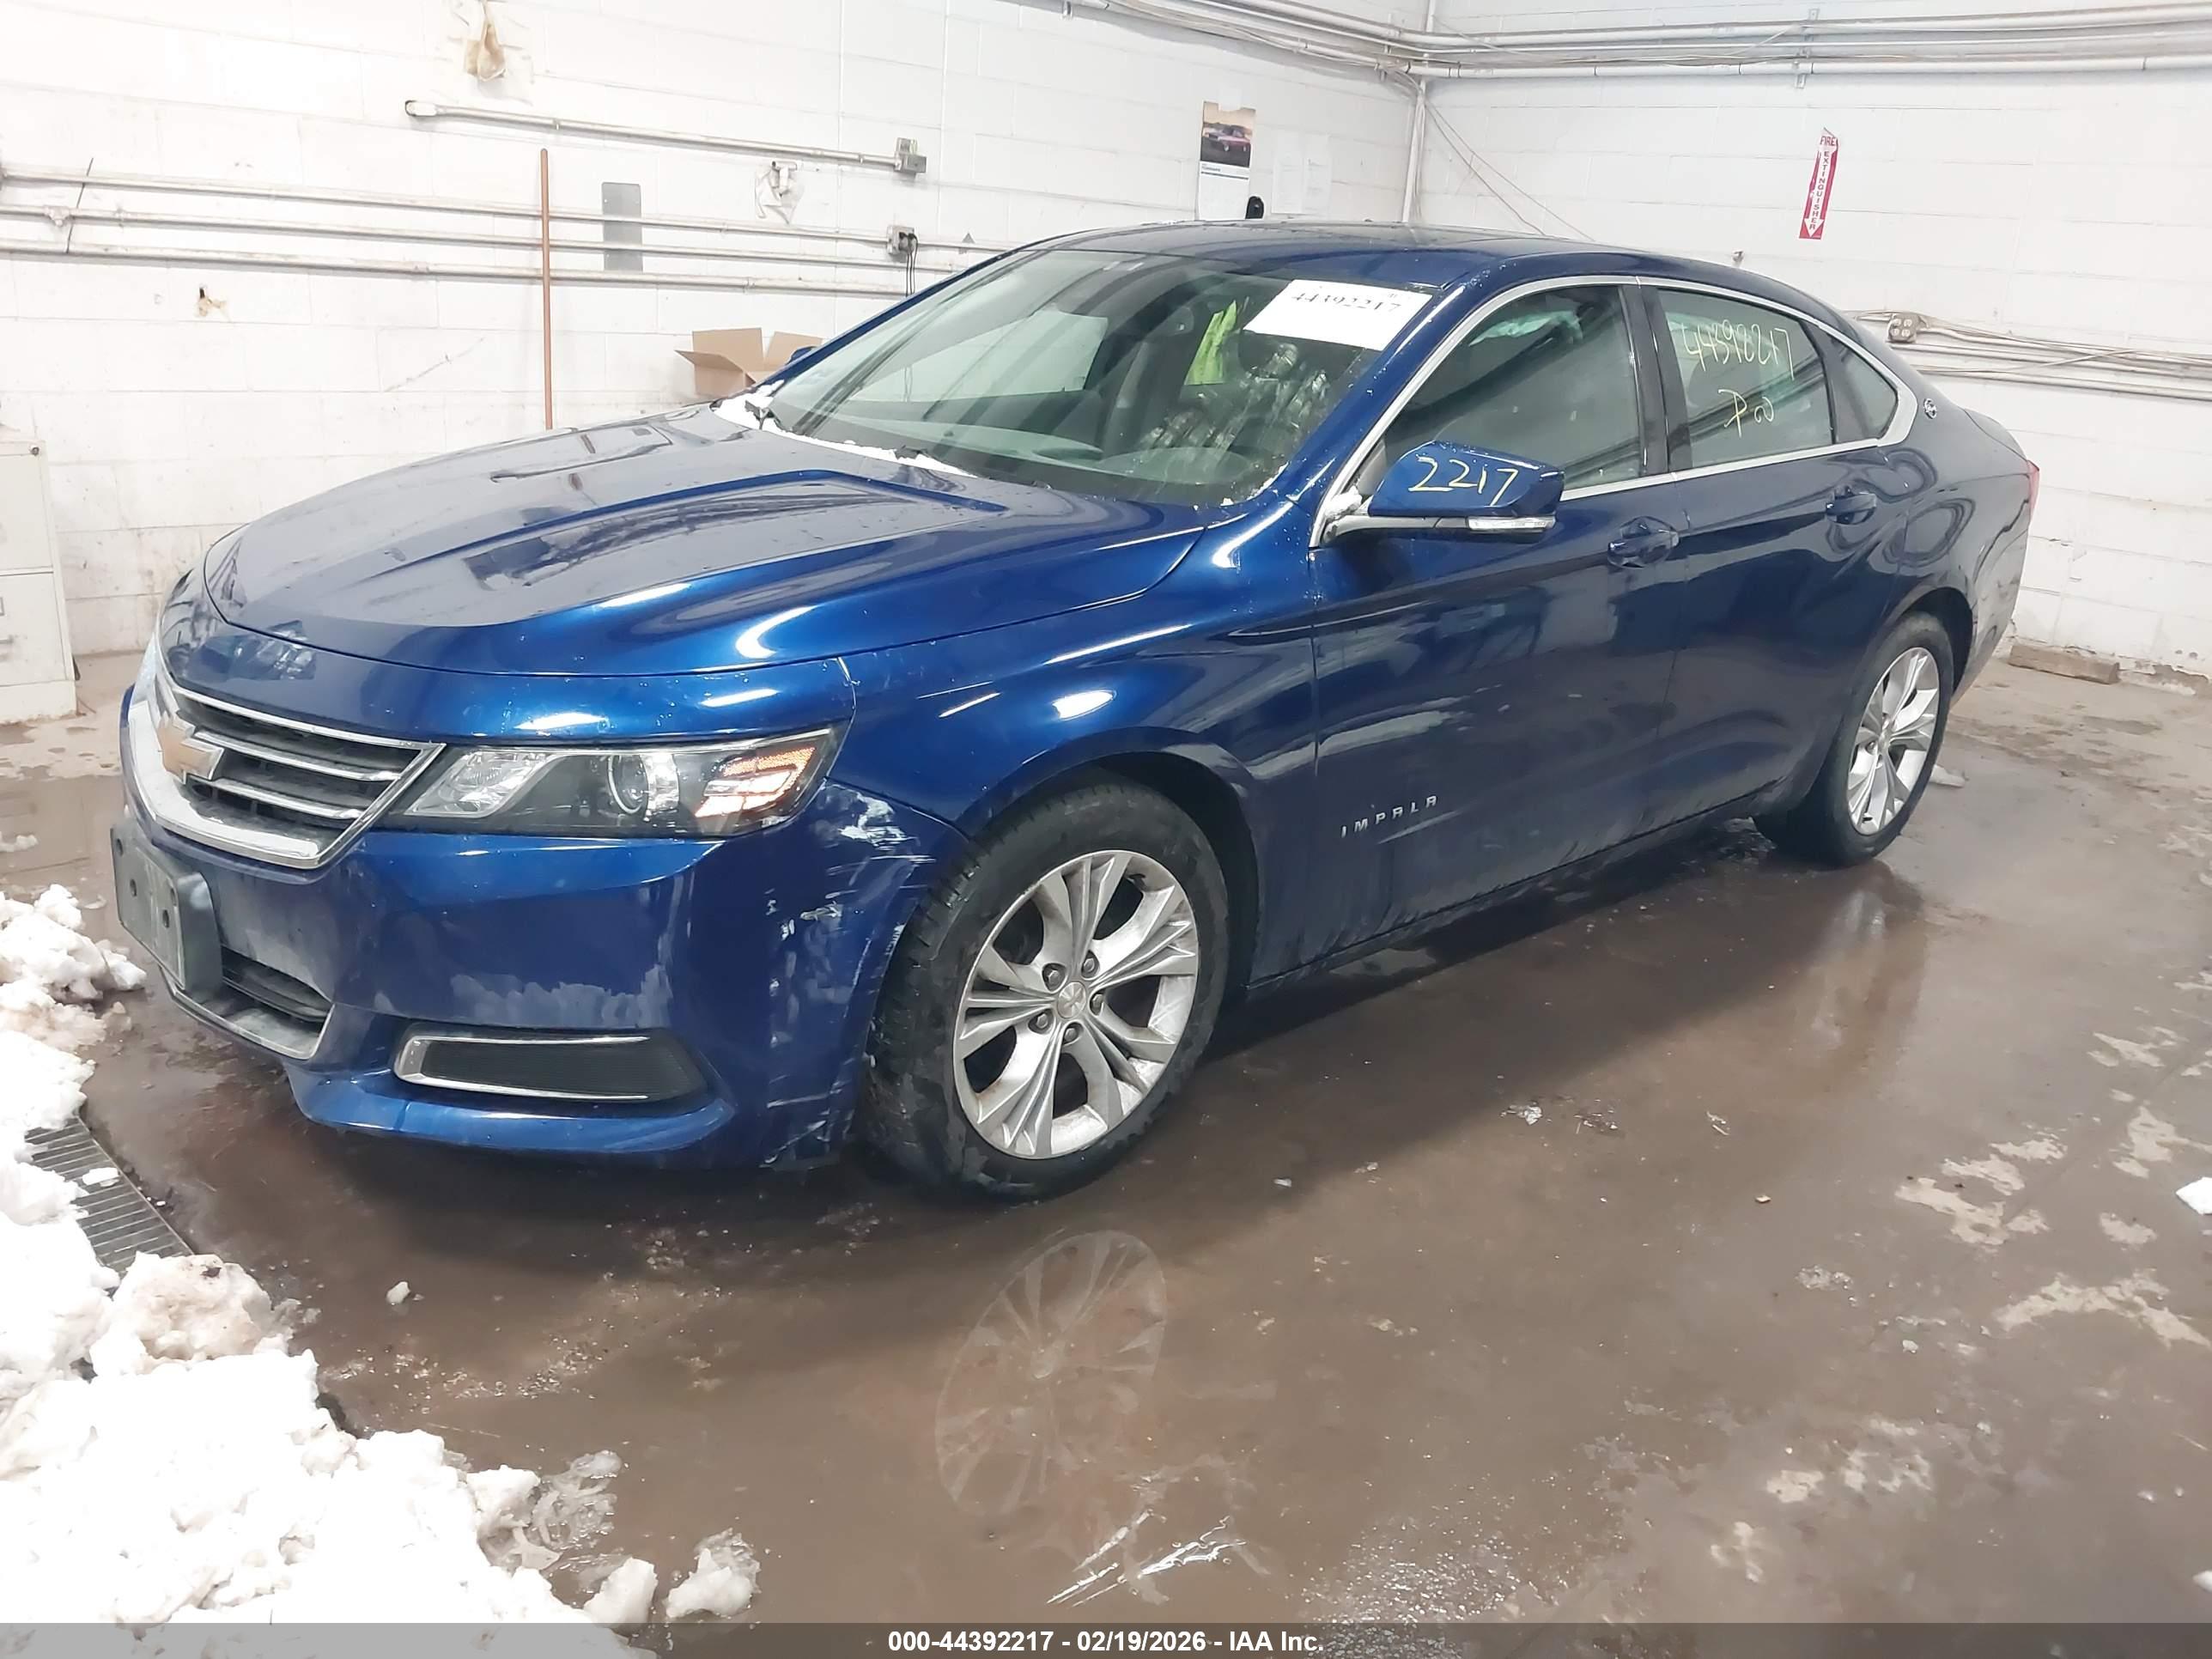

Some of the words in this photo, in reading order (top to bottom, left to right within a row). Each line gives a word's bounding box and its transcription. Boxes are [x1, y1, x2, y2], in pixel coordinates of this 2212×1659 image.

[1820, 136, 1837, 146] FIRE
[1809, 150, 1831, 230] EXTINGUISHER
[1408, 454, 1518, 507] 2217
[1341, 795, 1437, 838] IMPALA
